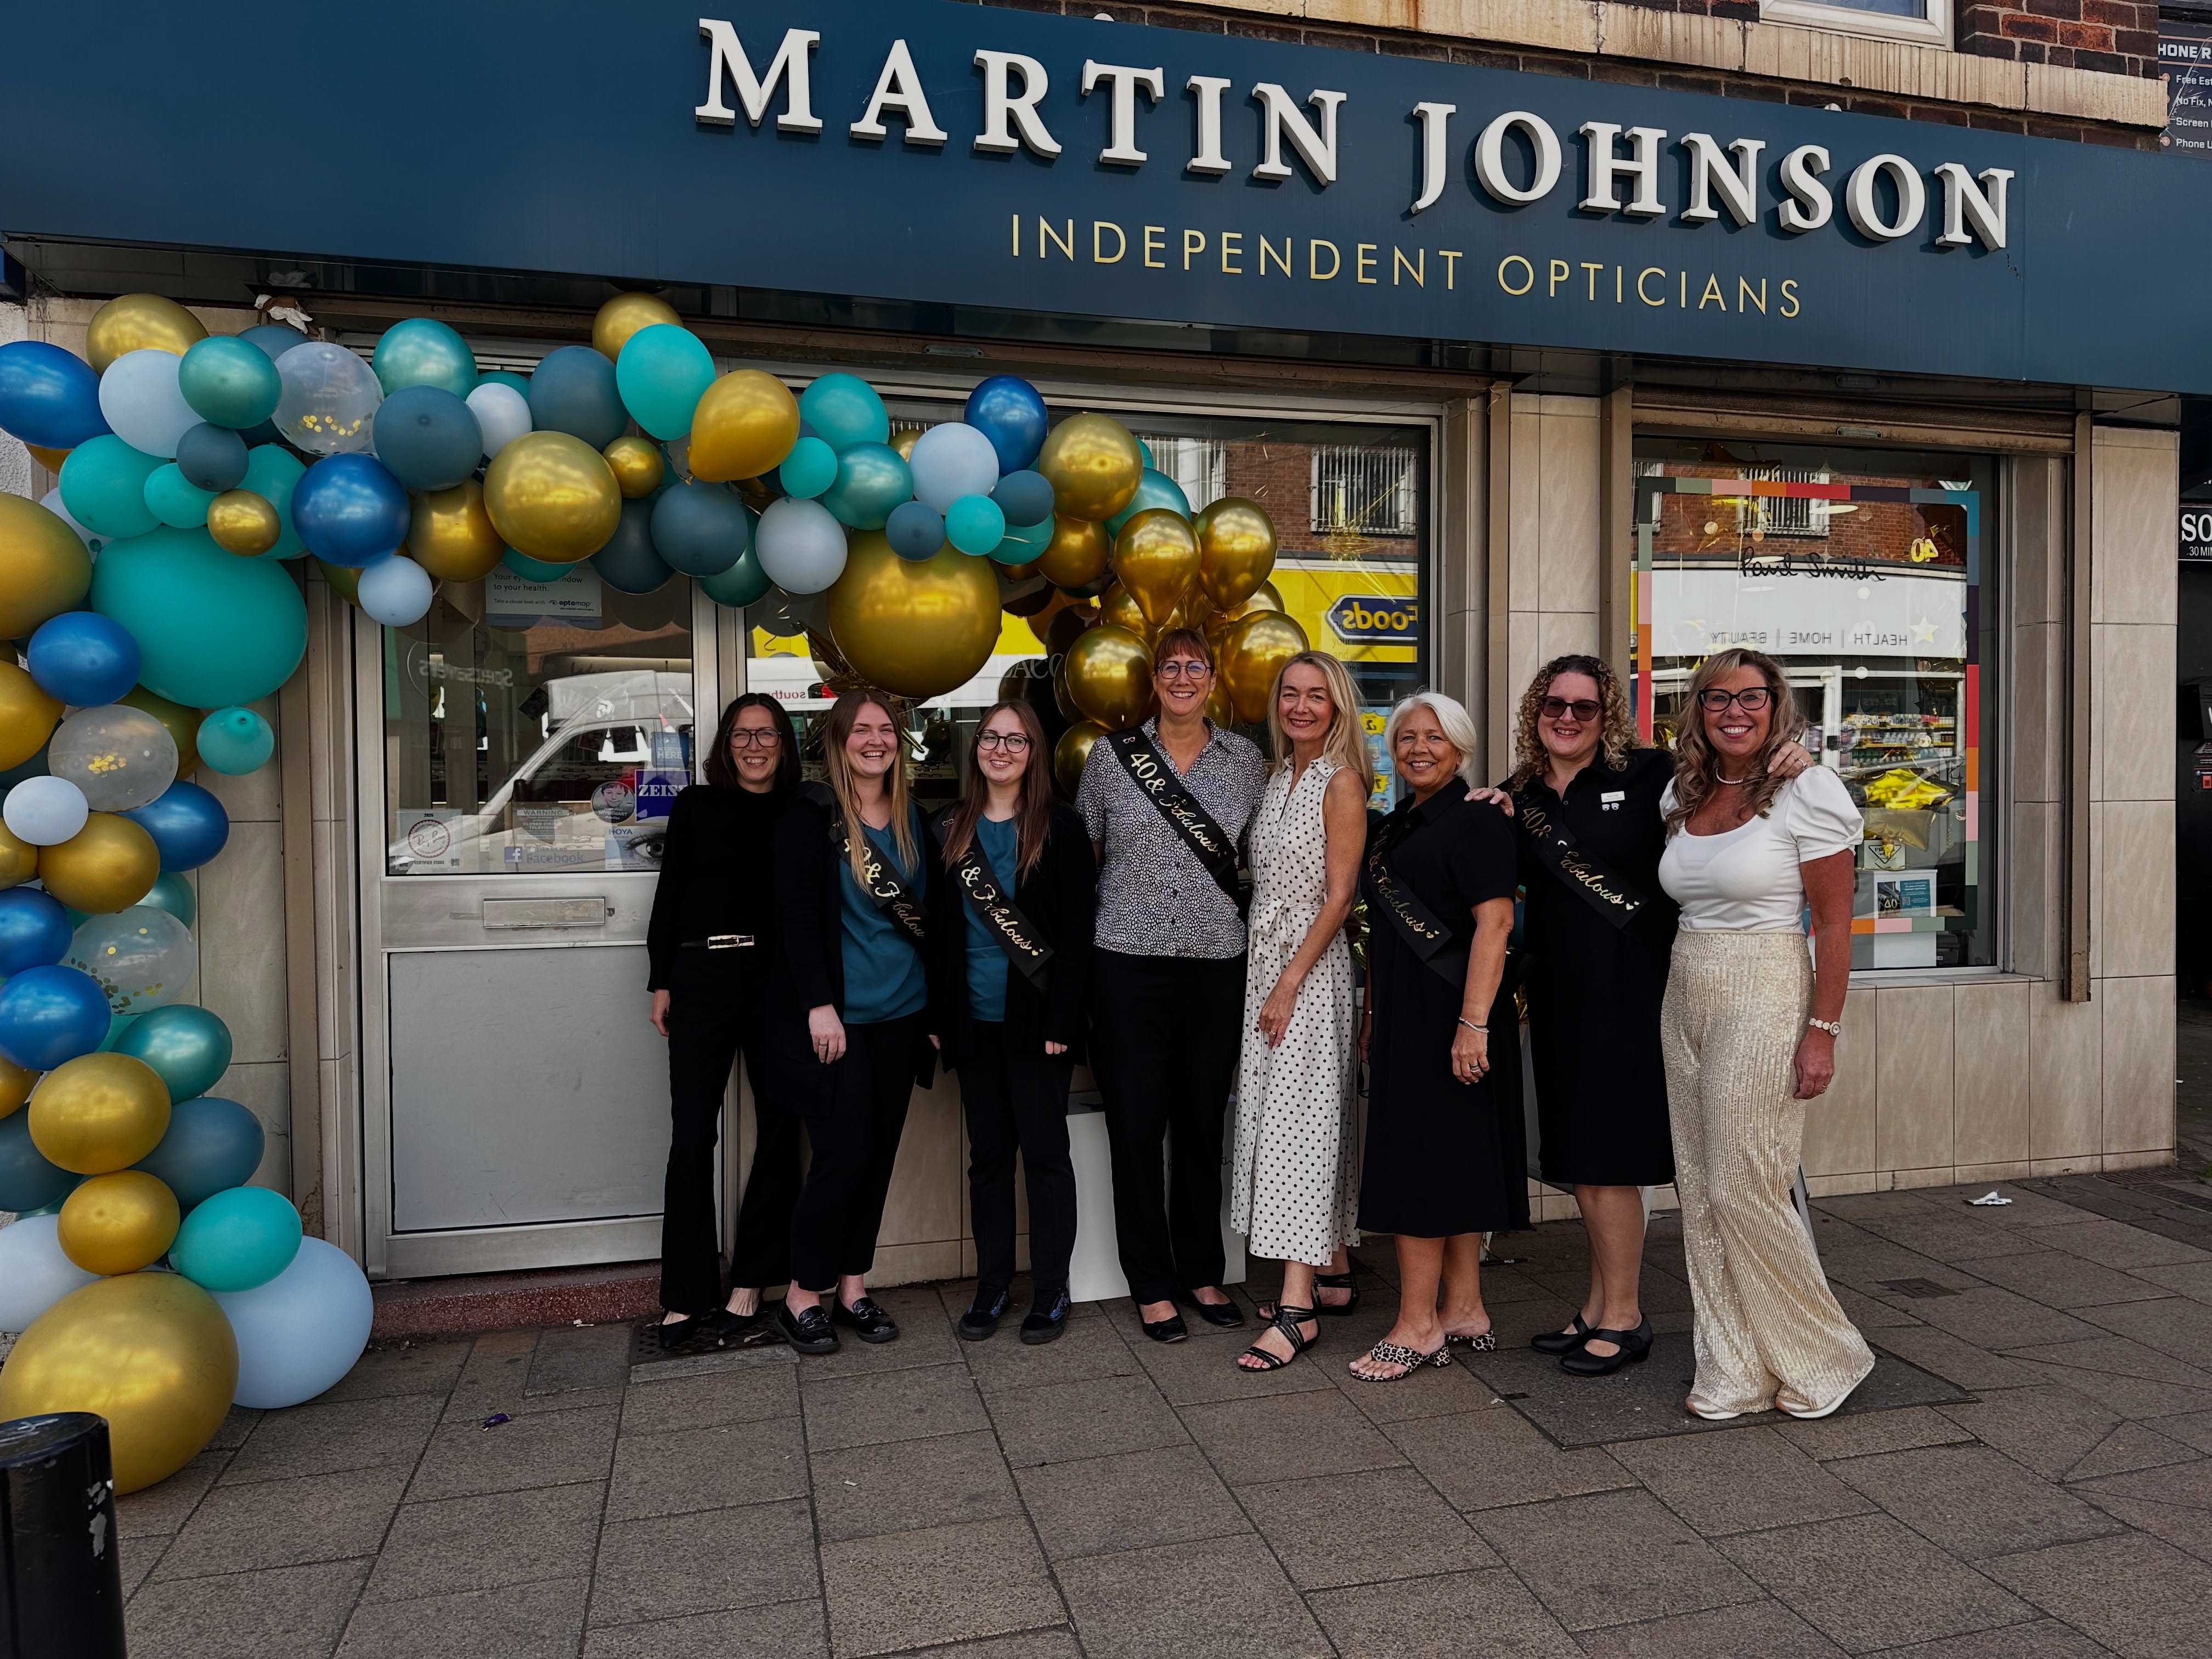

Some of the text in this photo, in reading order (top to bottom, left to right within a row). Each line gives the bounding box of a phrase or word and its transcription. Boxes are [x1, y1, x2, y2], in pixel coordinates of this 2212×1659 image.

[2176, 75, 2197, 85] Free
[2176, 96, 2189, 105] No
[2191, 97, 2206, 107] Fix,
[2176, 117, 2209, 128] Screen
[695, 18, 2015, 253] MARTIN JOHNSON
[2176, 138, 2205, 149] Phone
[1012, 213, 1801, 318] INDEPENDENT OPTICIANS
[1741, 546, 1887, 581] Paul Smith
[658, 751, 682, 759] HERE
[1130, 753, 1158, 779] 40
[527, 852, 584, 864] Facebook
